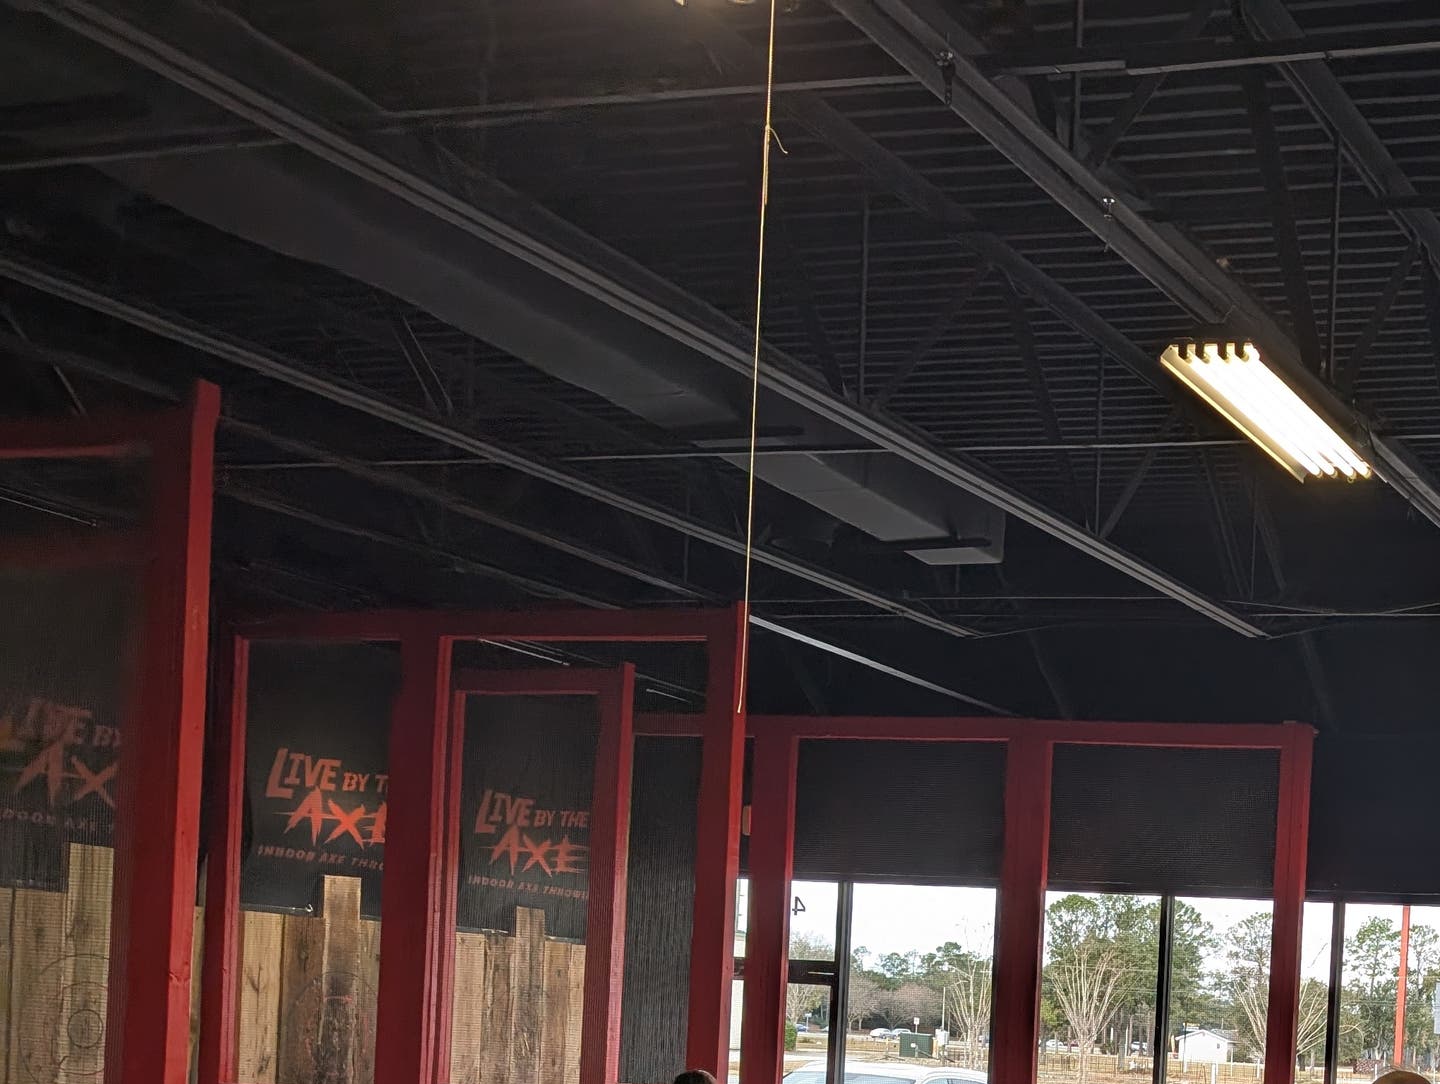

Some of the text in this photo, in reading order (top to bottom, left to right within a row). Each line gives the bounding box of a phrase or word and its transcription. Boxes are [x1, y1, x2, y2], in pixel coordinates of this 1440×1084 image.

[14, 735, 118, 808] AX
[265, 747, 342, 799] LIVE
[342, 772, 370, 792] BY
[475, 789, 590, 833] LIVE BY THE
[484, 825, 589, 877] AXE
